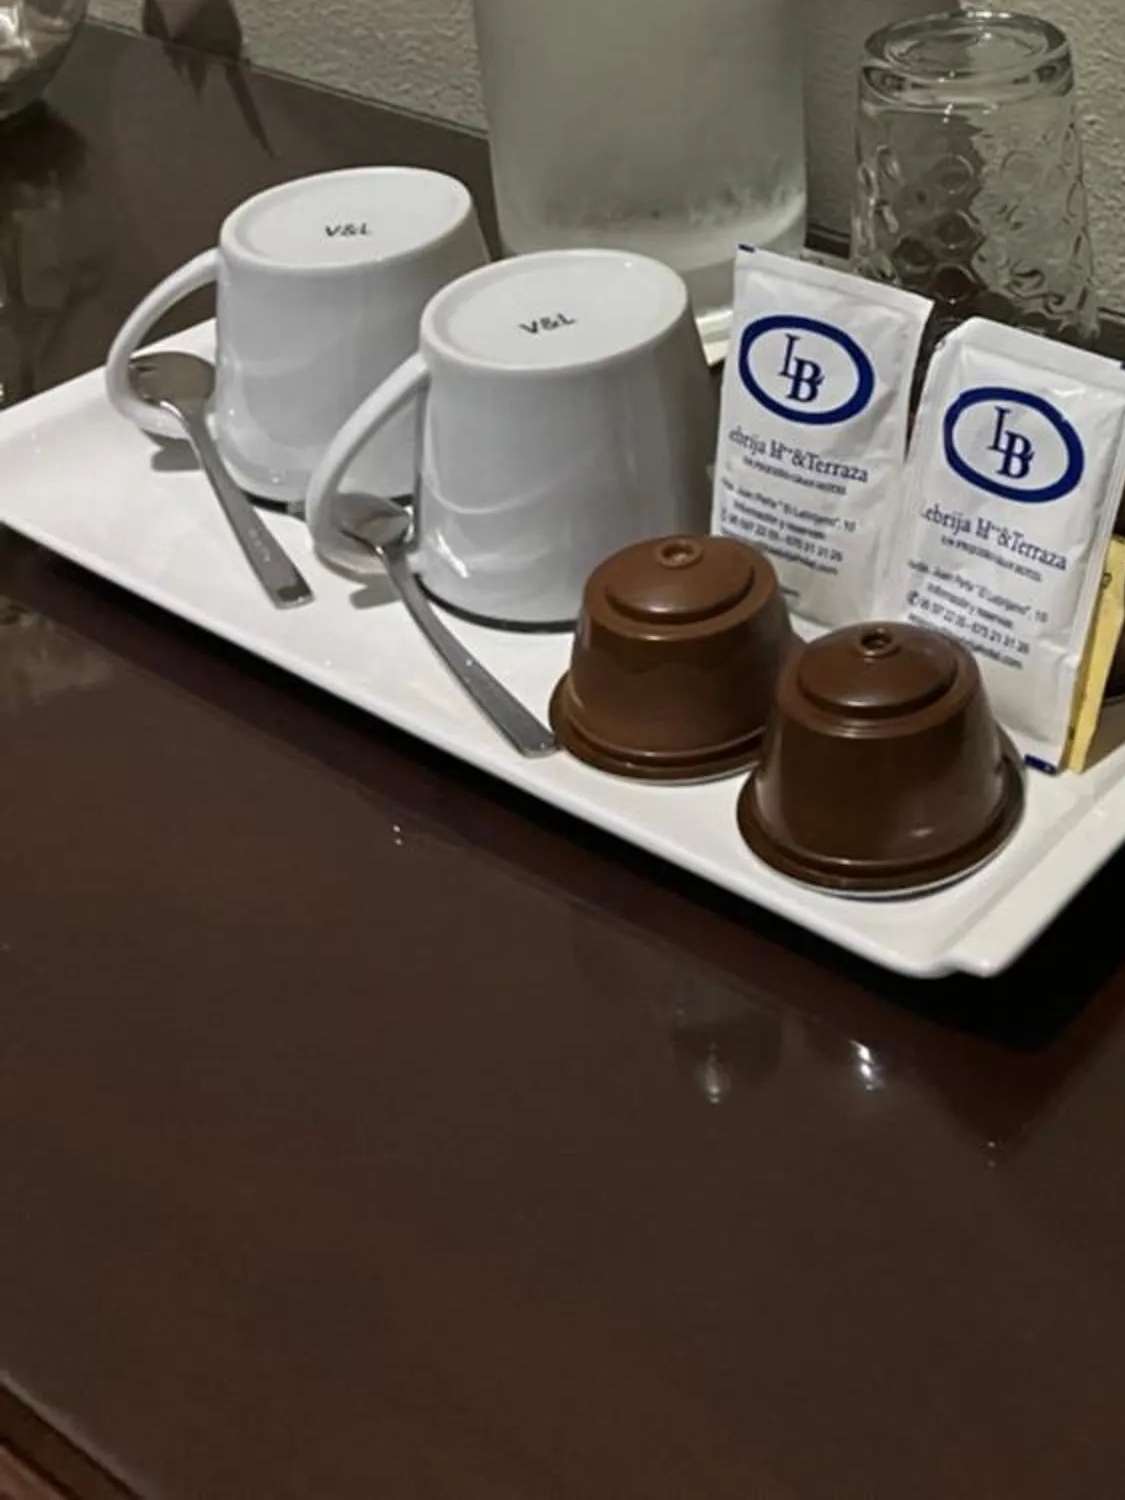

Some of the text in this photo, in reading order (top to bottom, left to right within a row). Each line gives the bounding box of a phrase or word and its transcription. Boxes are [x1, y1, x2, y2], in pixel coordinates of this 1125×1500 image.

[324, 223, 372, 238] V&L
[519, 312, 577, 336] V&L
[921, 503, 970, 535] ebrija
